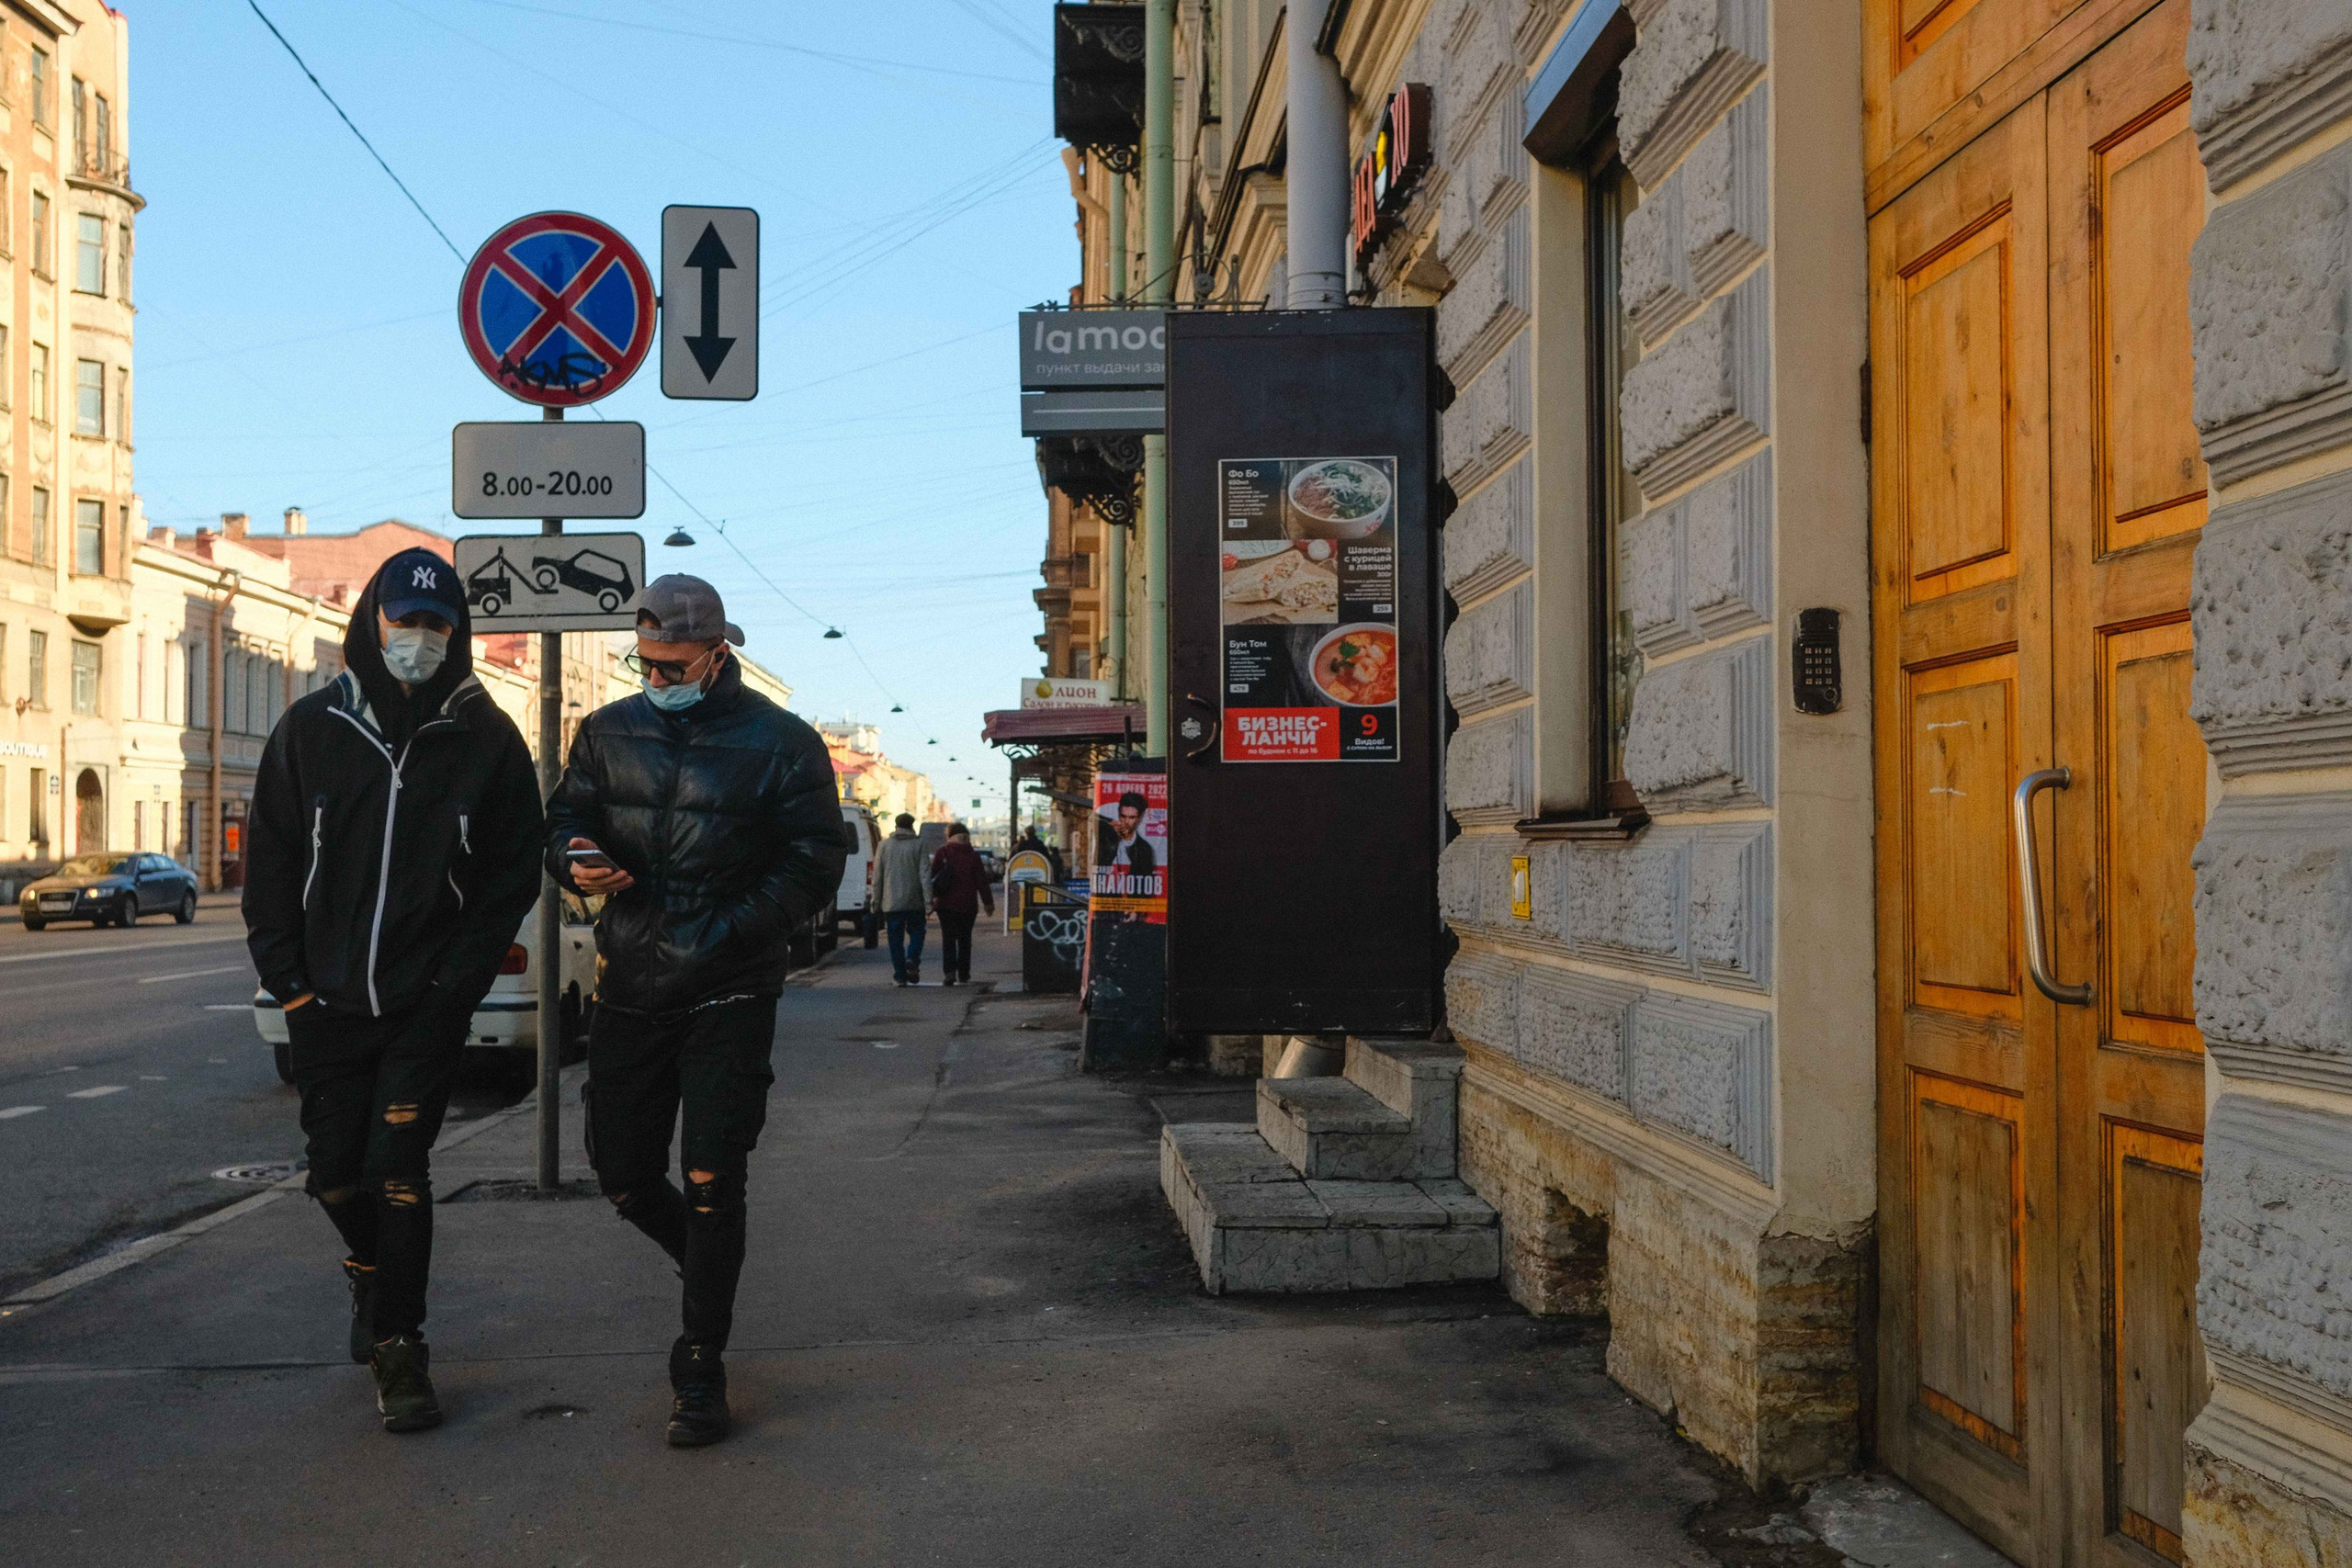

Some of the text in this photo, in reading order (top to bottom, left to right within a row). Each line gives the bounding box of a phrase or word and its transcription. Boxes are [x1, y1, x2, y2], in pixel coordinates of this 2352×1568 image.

[1036, 365, 1080, 378] пункт
[1084, 363, 1140, 375] выдачи
[1228, 469, 1259, 478] Фо Бо
[482, 470, 613, 497] 8.00-20.00
[1348, 547, 1392, 555] Шаверма
[1351, 554, 1392, 564] курицей
[412, 565, 436, 590] NY
[1229, 639, 1267, 649] Бун Том
[1238, 716, 1328, 731] БИЗНЕС-
[1360, 714, 1378, 736] 9
[1242, 731, 1317, 746] ЛАНЧИ
[1354, 738, 1385, 746] Видов!
[1091, 872, 1162, 896] НАЙОТОВ
